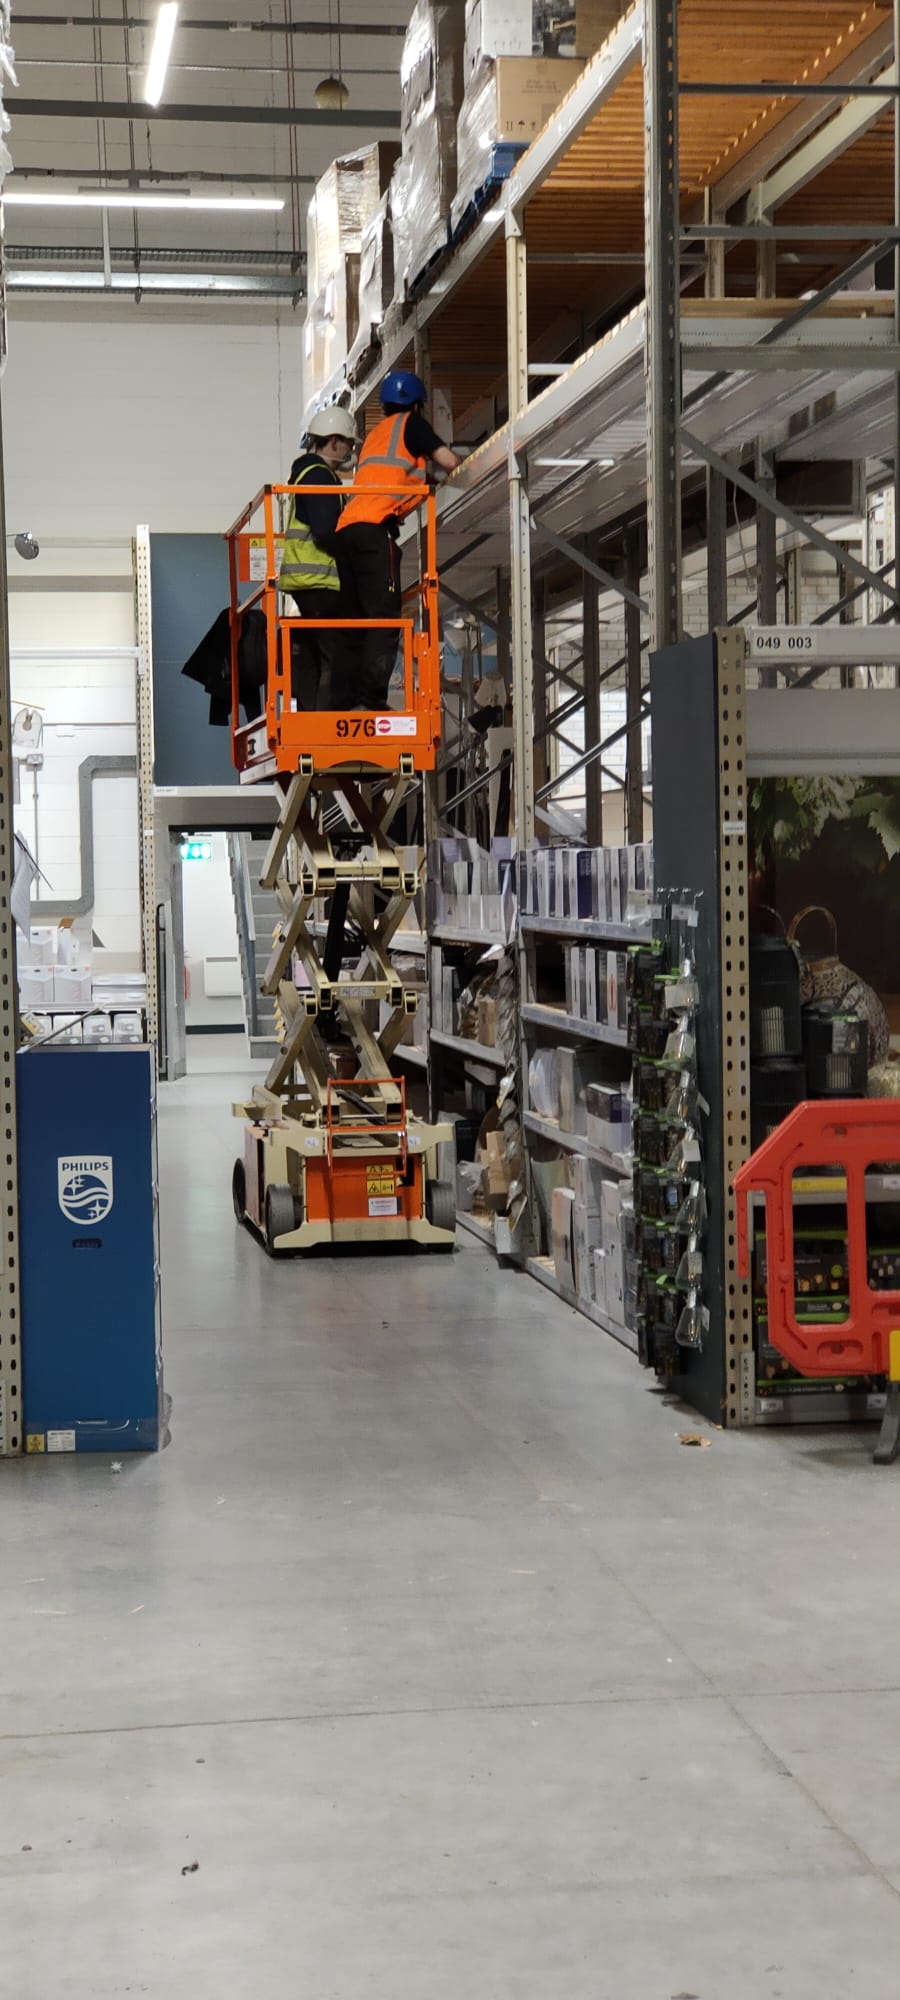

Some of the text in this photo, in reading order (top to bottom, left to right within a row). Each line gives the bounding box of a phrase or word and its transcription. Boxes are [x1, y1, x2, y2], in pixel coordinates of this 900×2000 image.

[756, 637, 812, 649] 049 003
[336, 719, 376, 738] 976
[62, 1161, 109, 1172] PHILIPS
